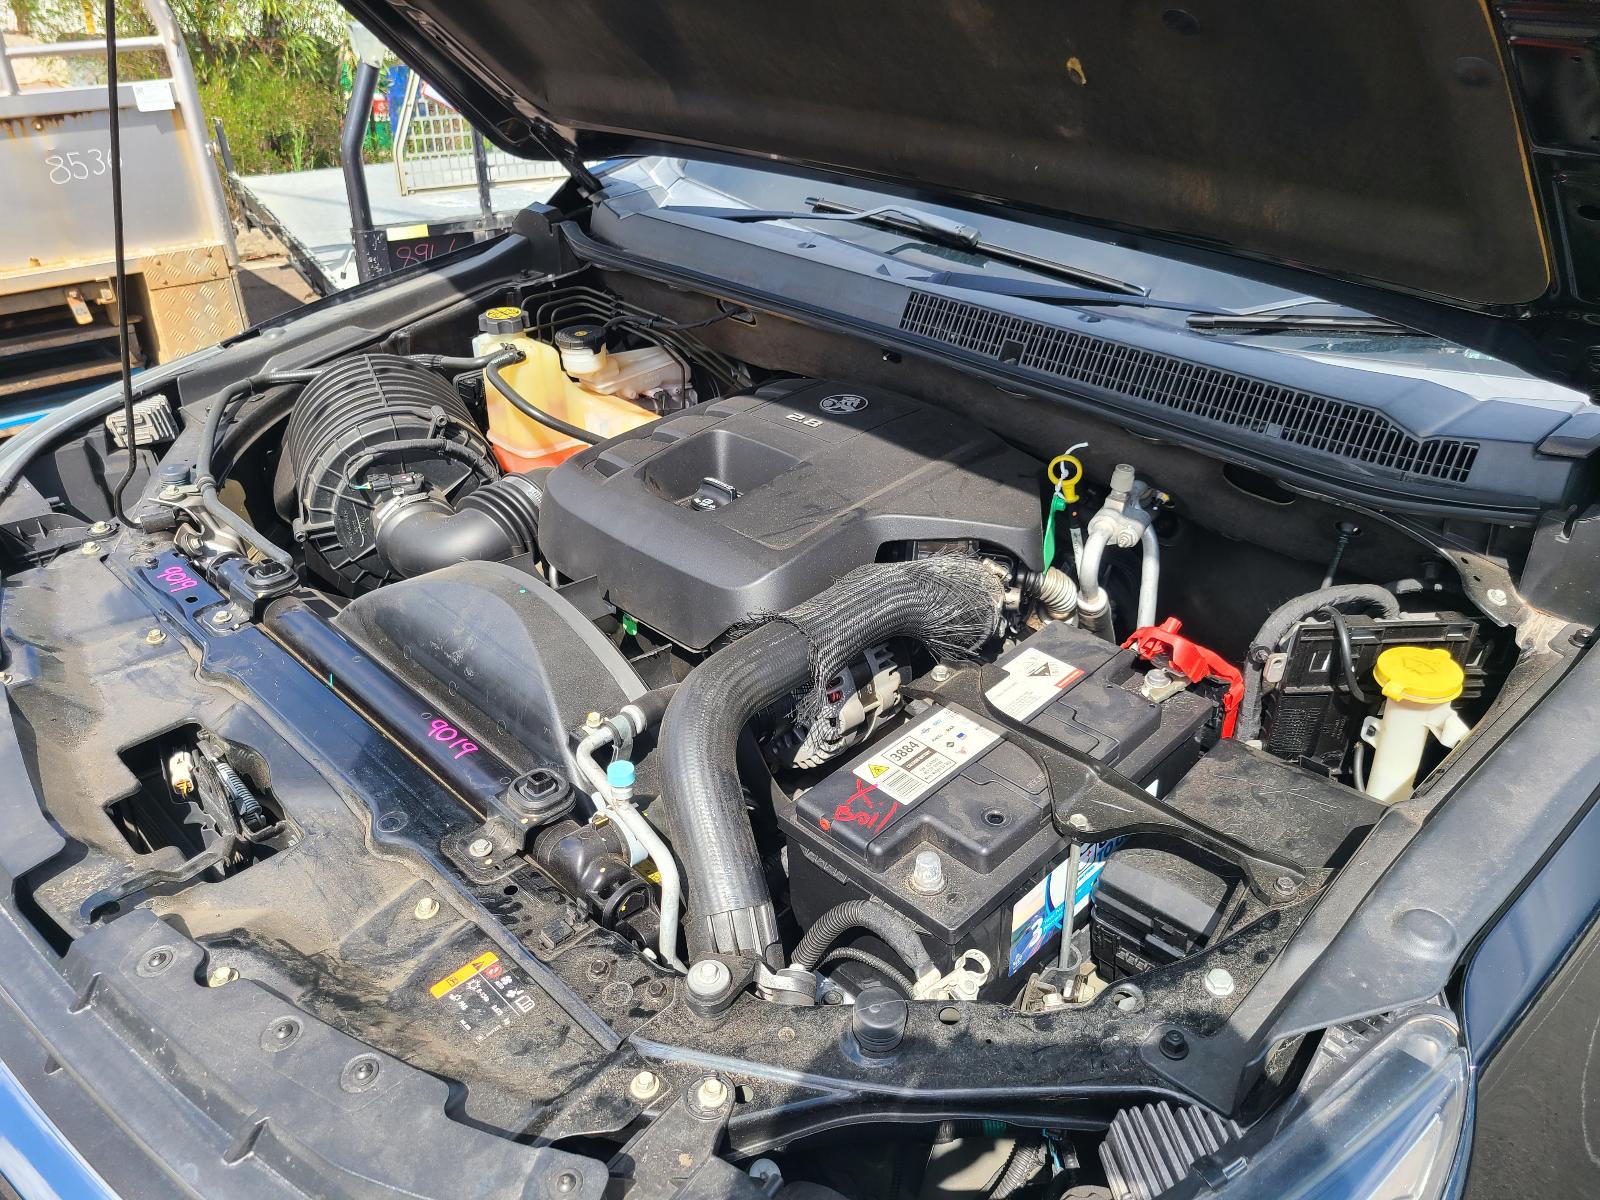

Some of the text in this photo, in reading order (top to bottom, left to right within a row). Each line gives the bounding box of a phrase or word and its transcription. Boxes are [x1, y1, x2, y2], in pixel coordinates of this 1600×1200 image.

[785, 412, 823, 428] 2.8
[157, 566, 198, 593] 9019
[428, 720, 479, 760] 9019
[889, 740, 920, 762] 3884
